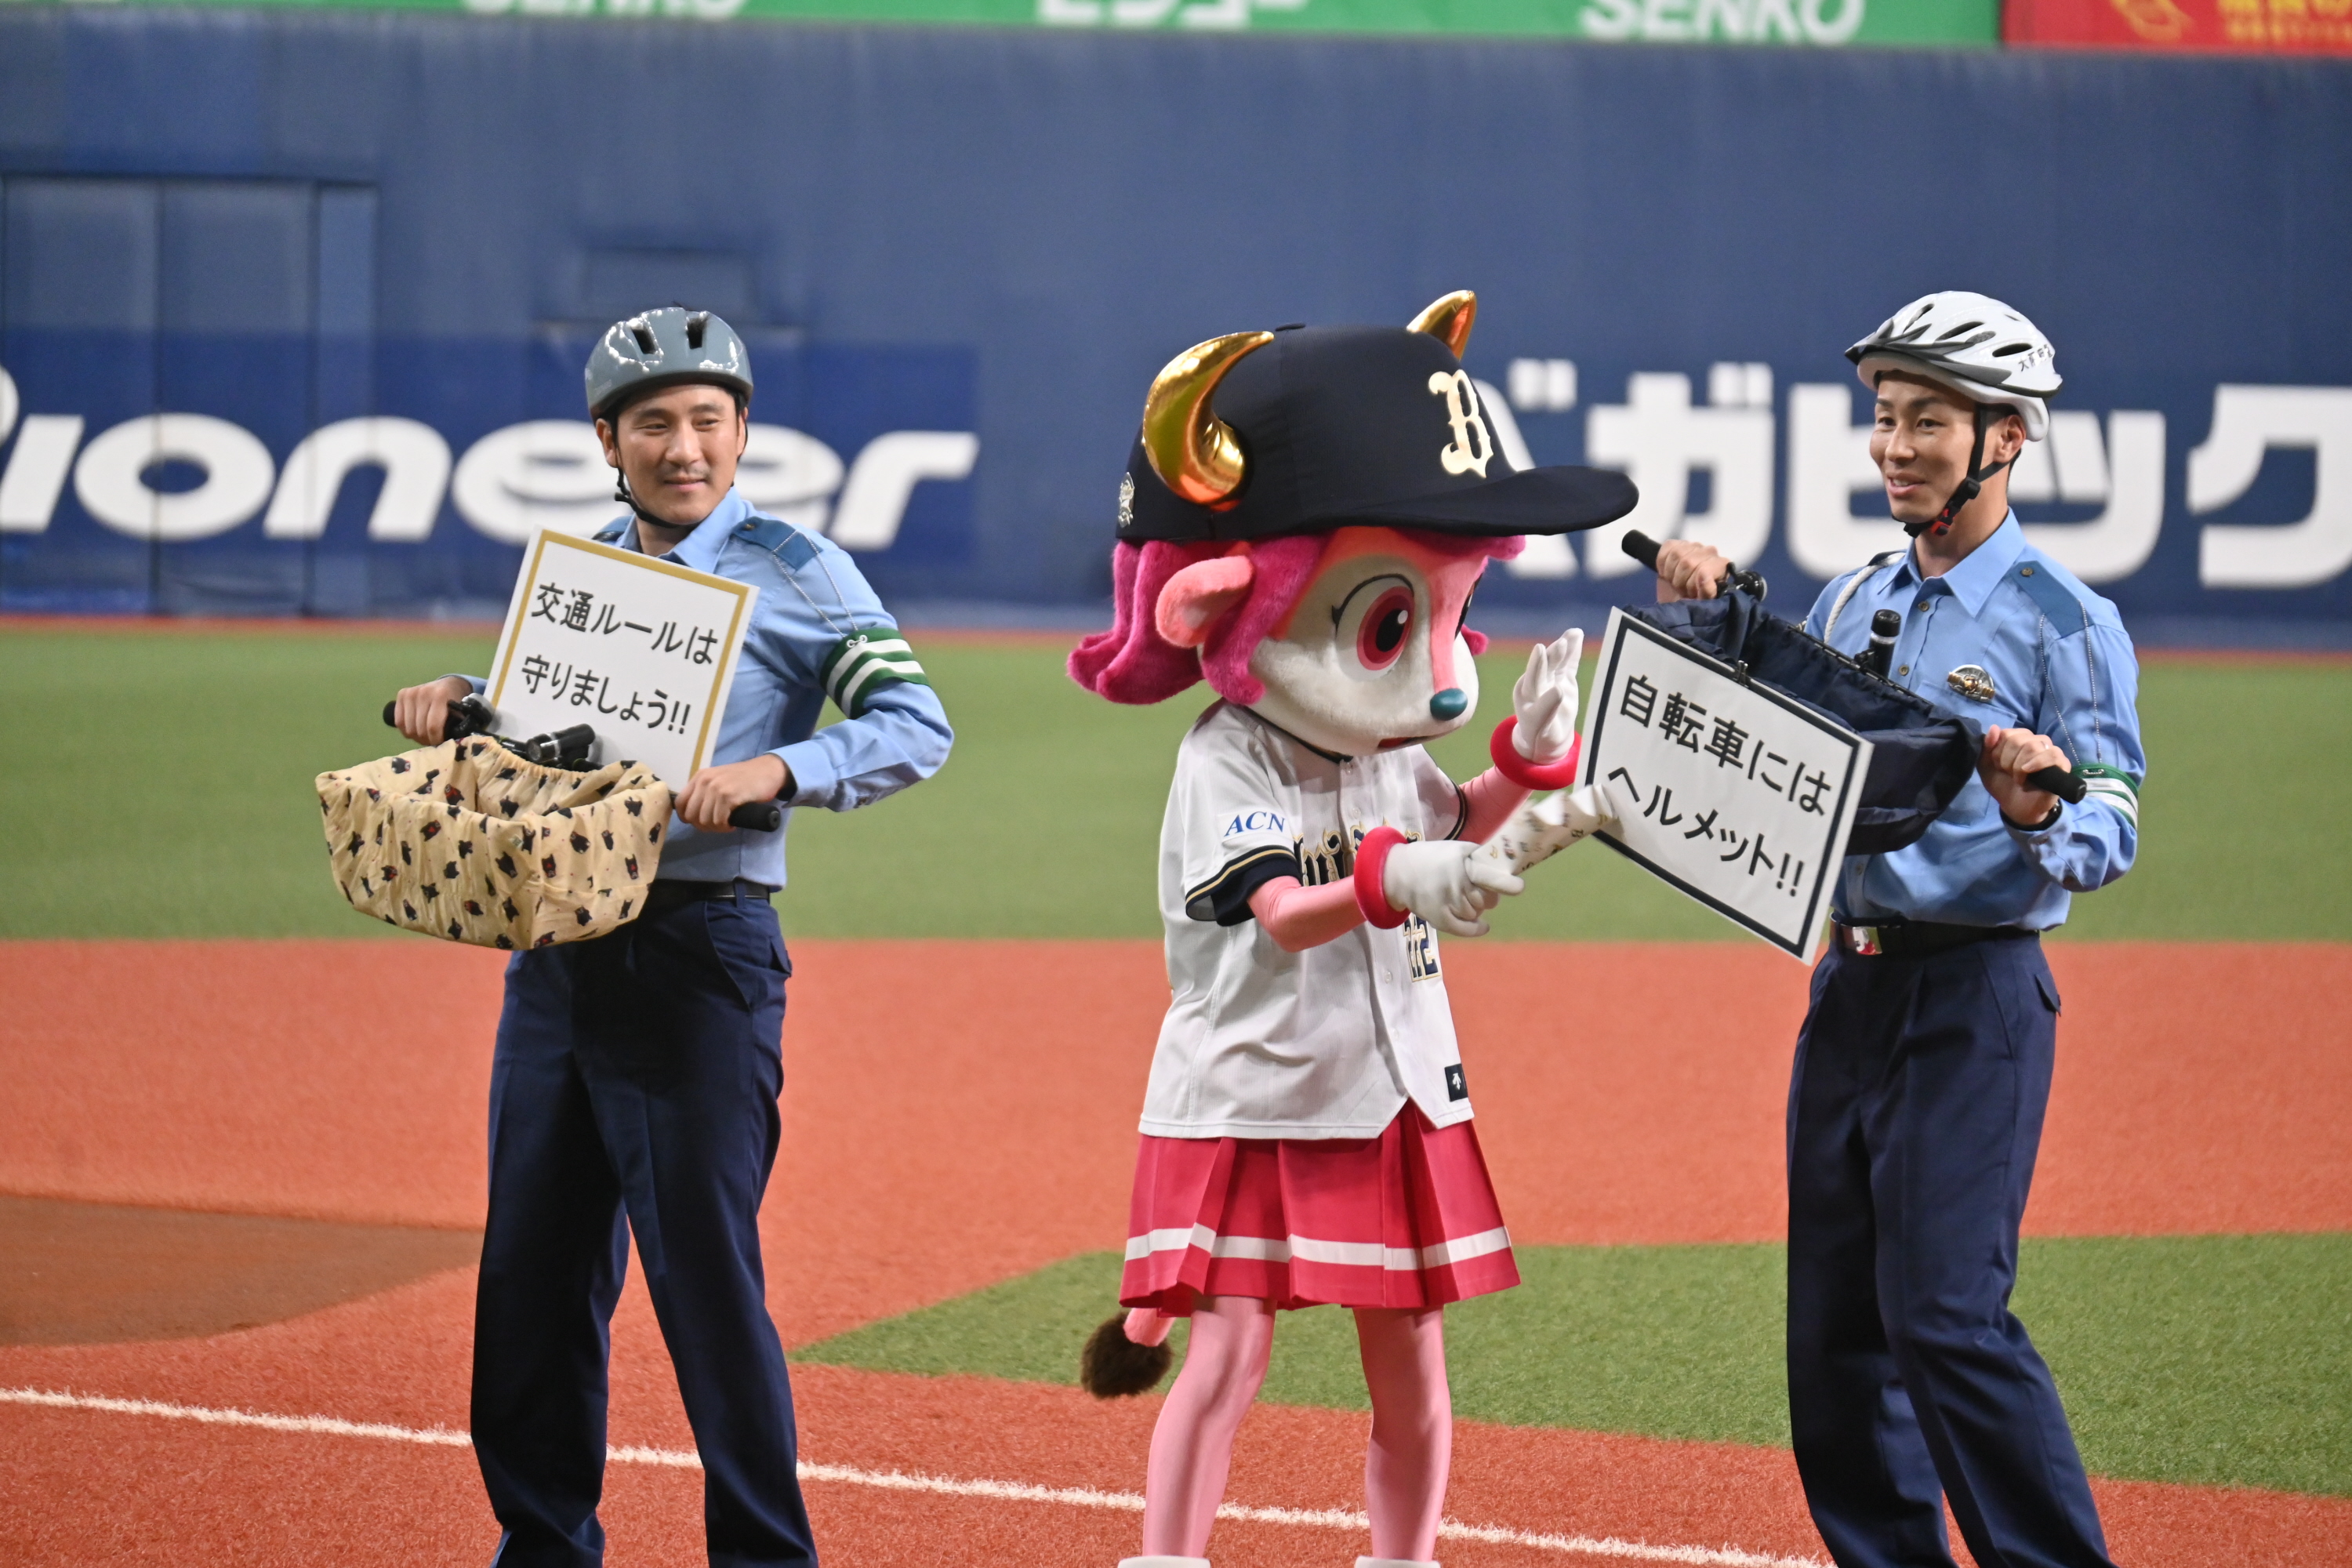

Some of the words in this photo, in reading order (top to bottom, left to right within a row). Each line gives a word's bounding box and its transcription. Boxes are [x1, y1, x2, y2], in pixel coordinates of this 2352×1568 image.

[0, 363, 979, 549] ioneer
[1428, 368, 1494, 480] B
[531, 582, 718, 665] 交通ルールは
[521, 654, 691, 735] 守りましょう!!
[1620, 673, 1831, 816] 自転車には
[1223, 811, 1286, 837] ACN
[1607, 766, 1804, 898] ヘルメット!!
